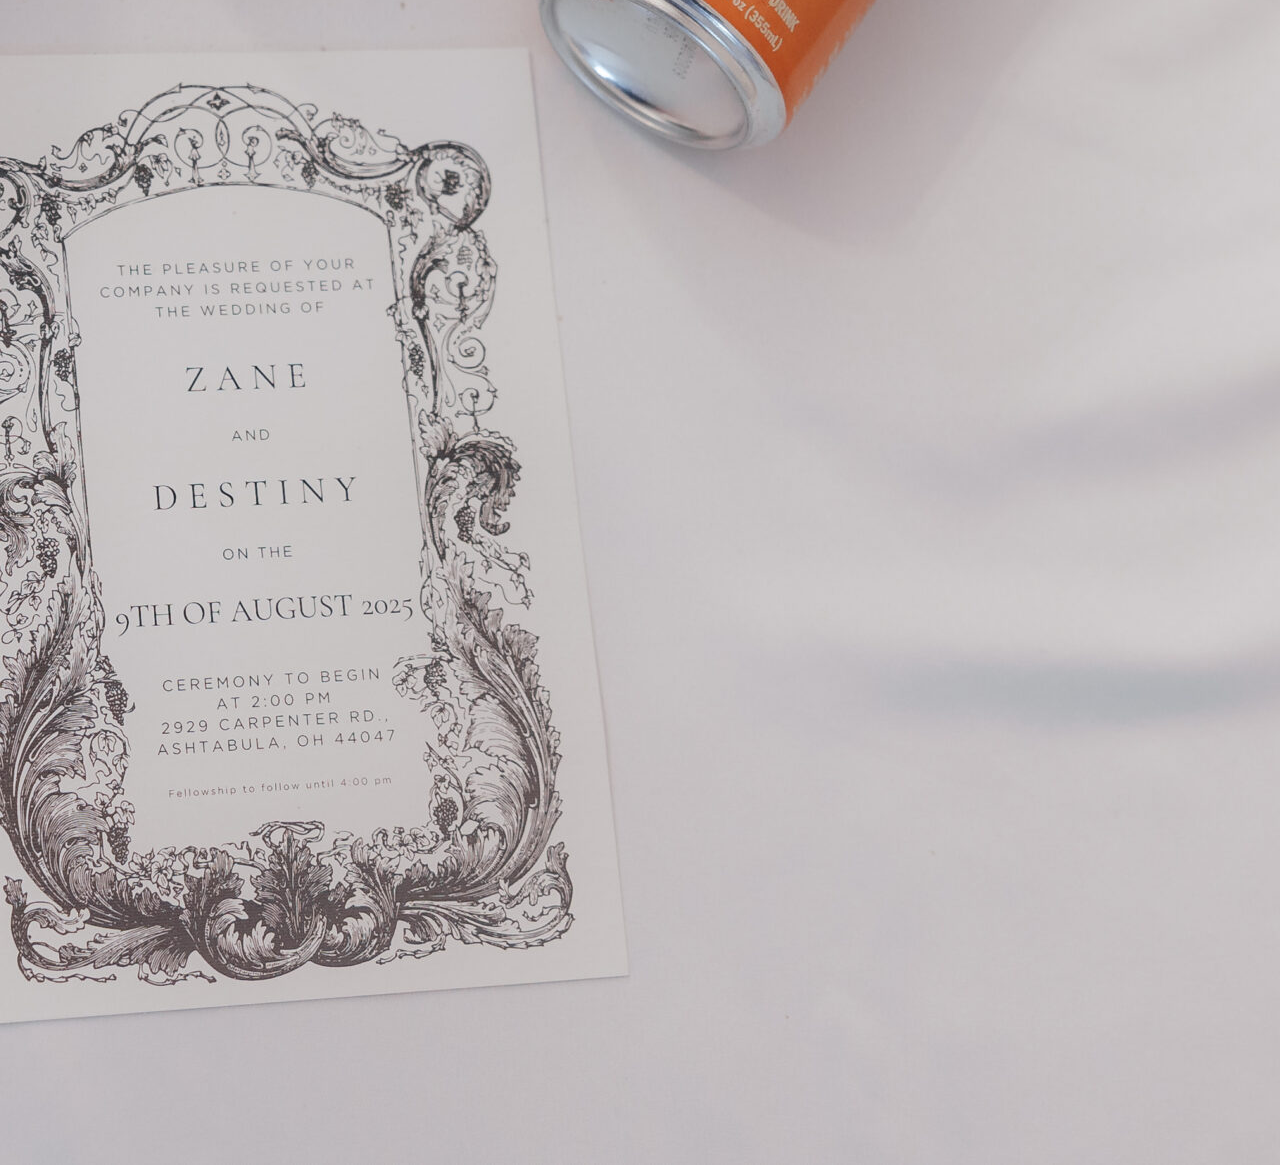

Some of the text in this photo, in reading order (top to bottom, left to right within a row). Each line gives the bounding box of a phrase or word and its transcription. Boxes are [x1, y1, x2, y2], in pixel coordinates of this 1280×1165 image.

[744, 5, 783, 52] (355mL)
[117, 258, 356, 277] THE PLEASURE OF YOUR
[100, 278, 375, 299] COMPANY IS REQUESTED AT
[155, 301, 325, 319] THE WEDDING OF
[185, 363, 307, 392] ZANE
[231, 428, 271, 442] AND
[153, 476, 357, 511] DESTINY
[222, 545, 293, 560] ON THE
[115, 594, 414, 636] 9TH OF AUGUST 2025
[162, 667, 381, 692] CEREMONY TO BEGIN
[216, 691, 331, 710] AT 2:00 PM
[161, 719, 209, 735] 2929
[219, 711, 339, 731] CARPENTER
[157, 729, 395, 756] ASHTABULA, OH 44047
[168, 776, 392, 798] Fellowship to follow until 4:00 pm
